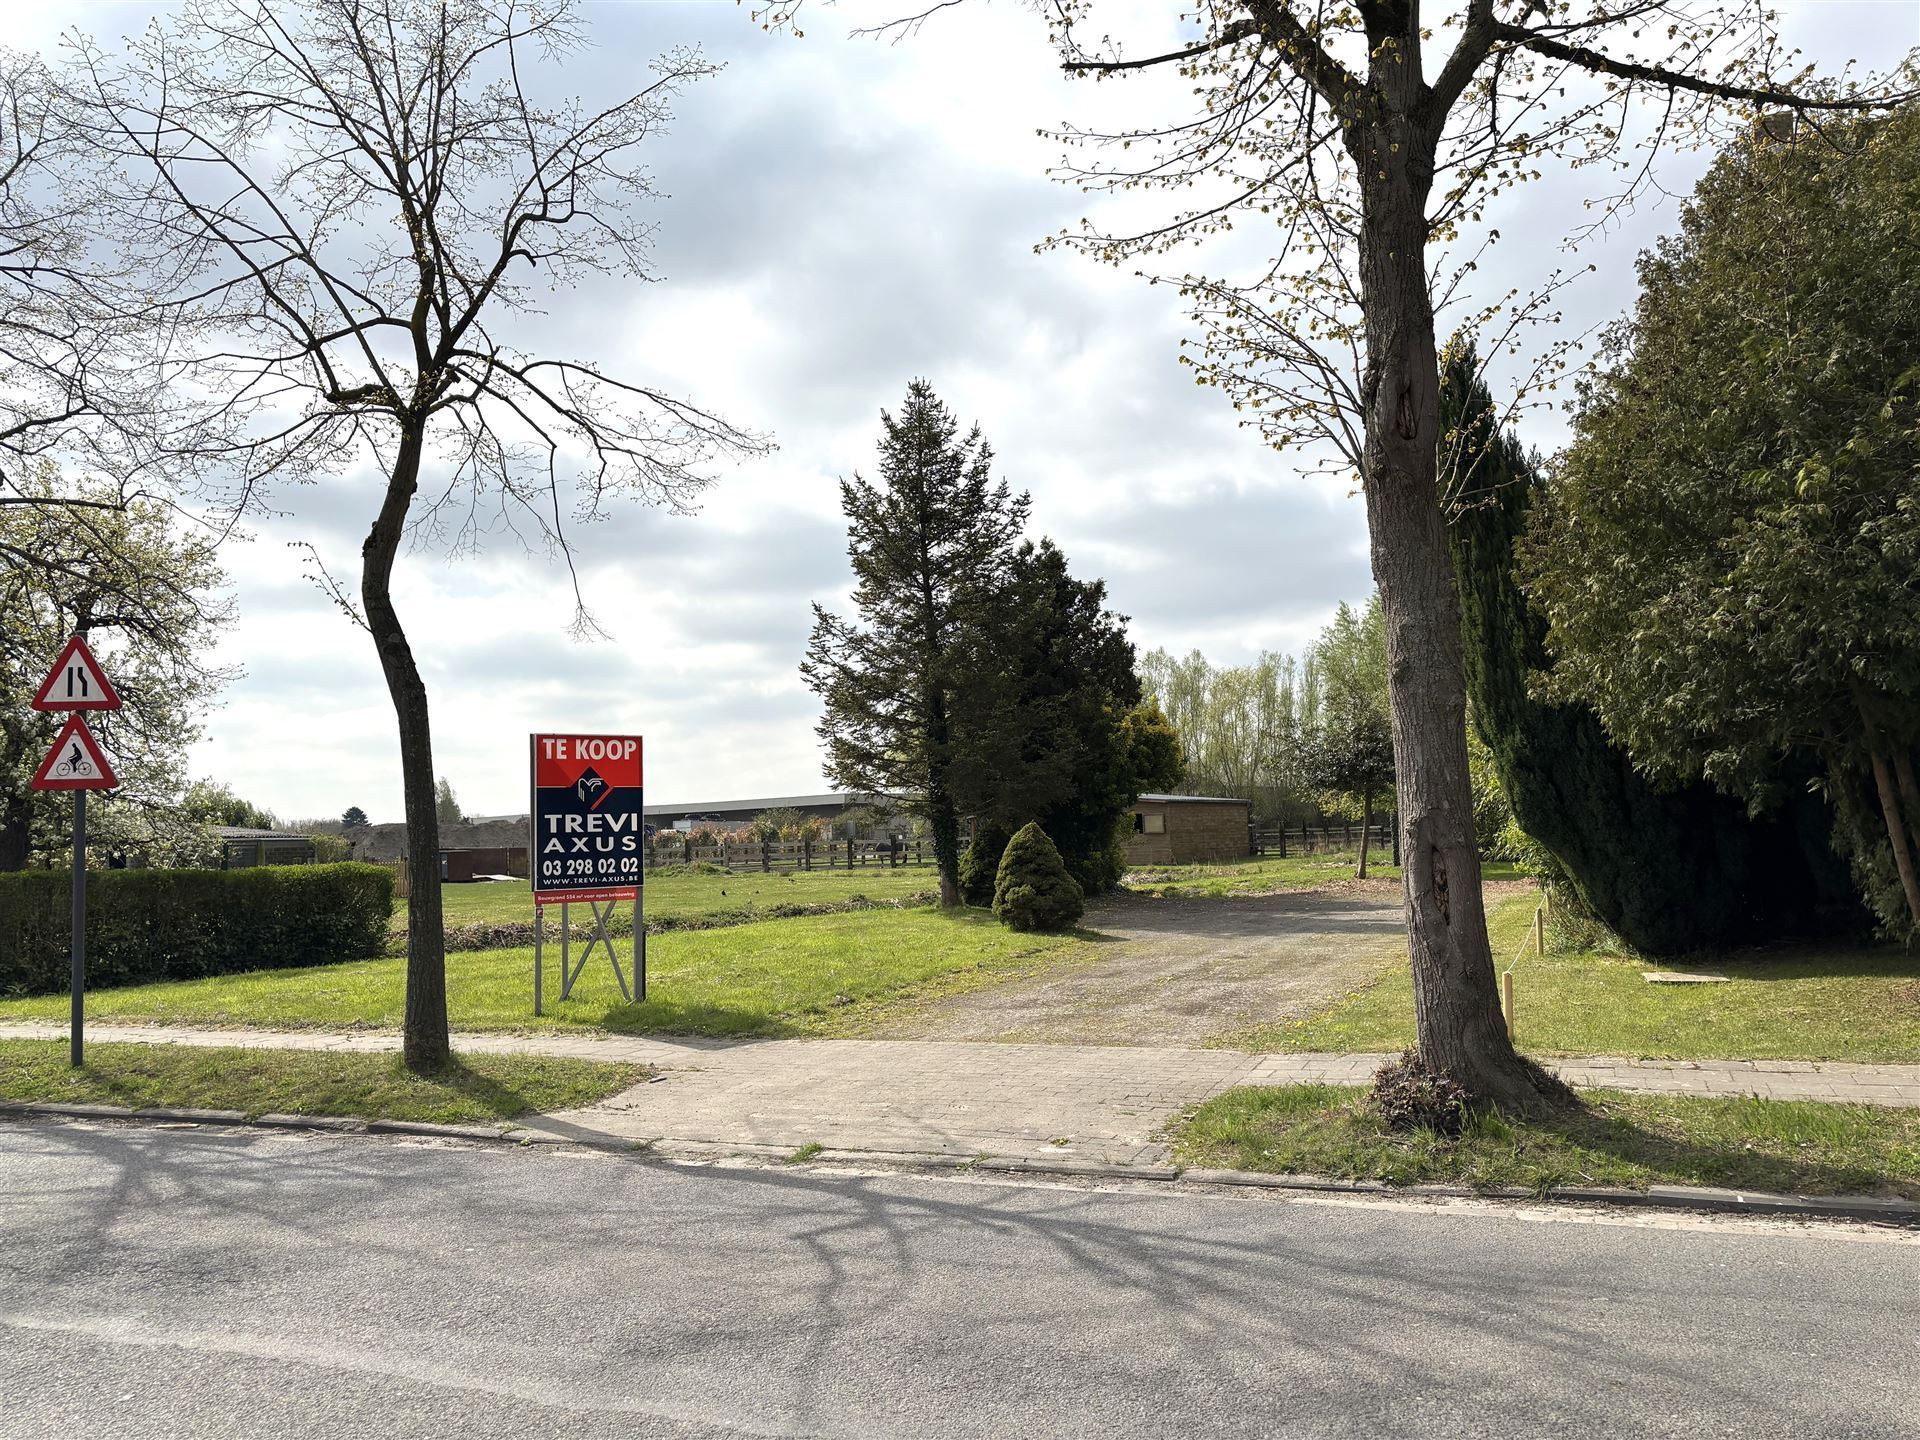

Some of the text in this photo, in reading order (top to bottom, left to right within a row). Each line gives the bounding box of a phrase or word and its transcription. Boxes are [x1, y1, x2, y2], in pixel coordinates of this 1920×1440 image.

[543, 738, 637, 760] TE KOOP
[544, 813, 638, 833] TREVI
[543, 835, 637, 854] AXUS
[543, 857, 638, 876] 03 298 02 02
[543, 875, 639, 885] WWW.TREVI-AXUS.BE
